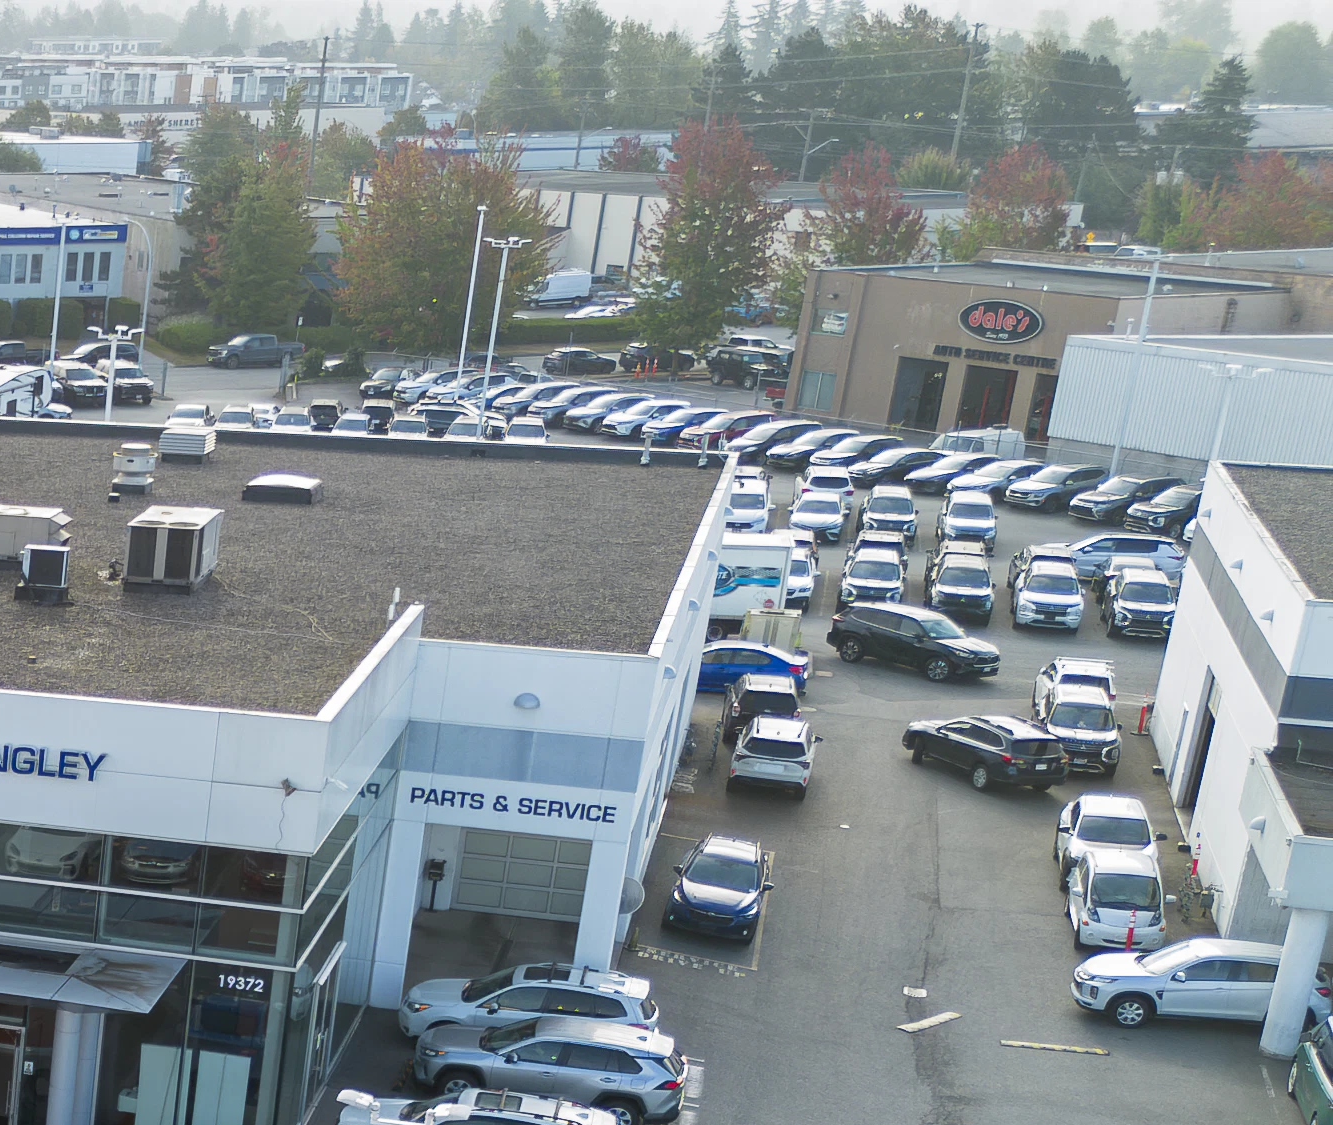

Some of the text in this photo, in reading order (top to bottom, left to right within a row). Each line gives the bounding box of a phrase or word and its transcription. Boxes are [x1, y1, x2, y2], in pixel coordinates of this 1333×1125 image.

[968, 305, 1030, 333] dale's
[410, 787, 617, 824] PARTS & SERVICE
[219, 974, 264, 992] 19372
